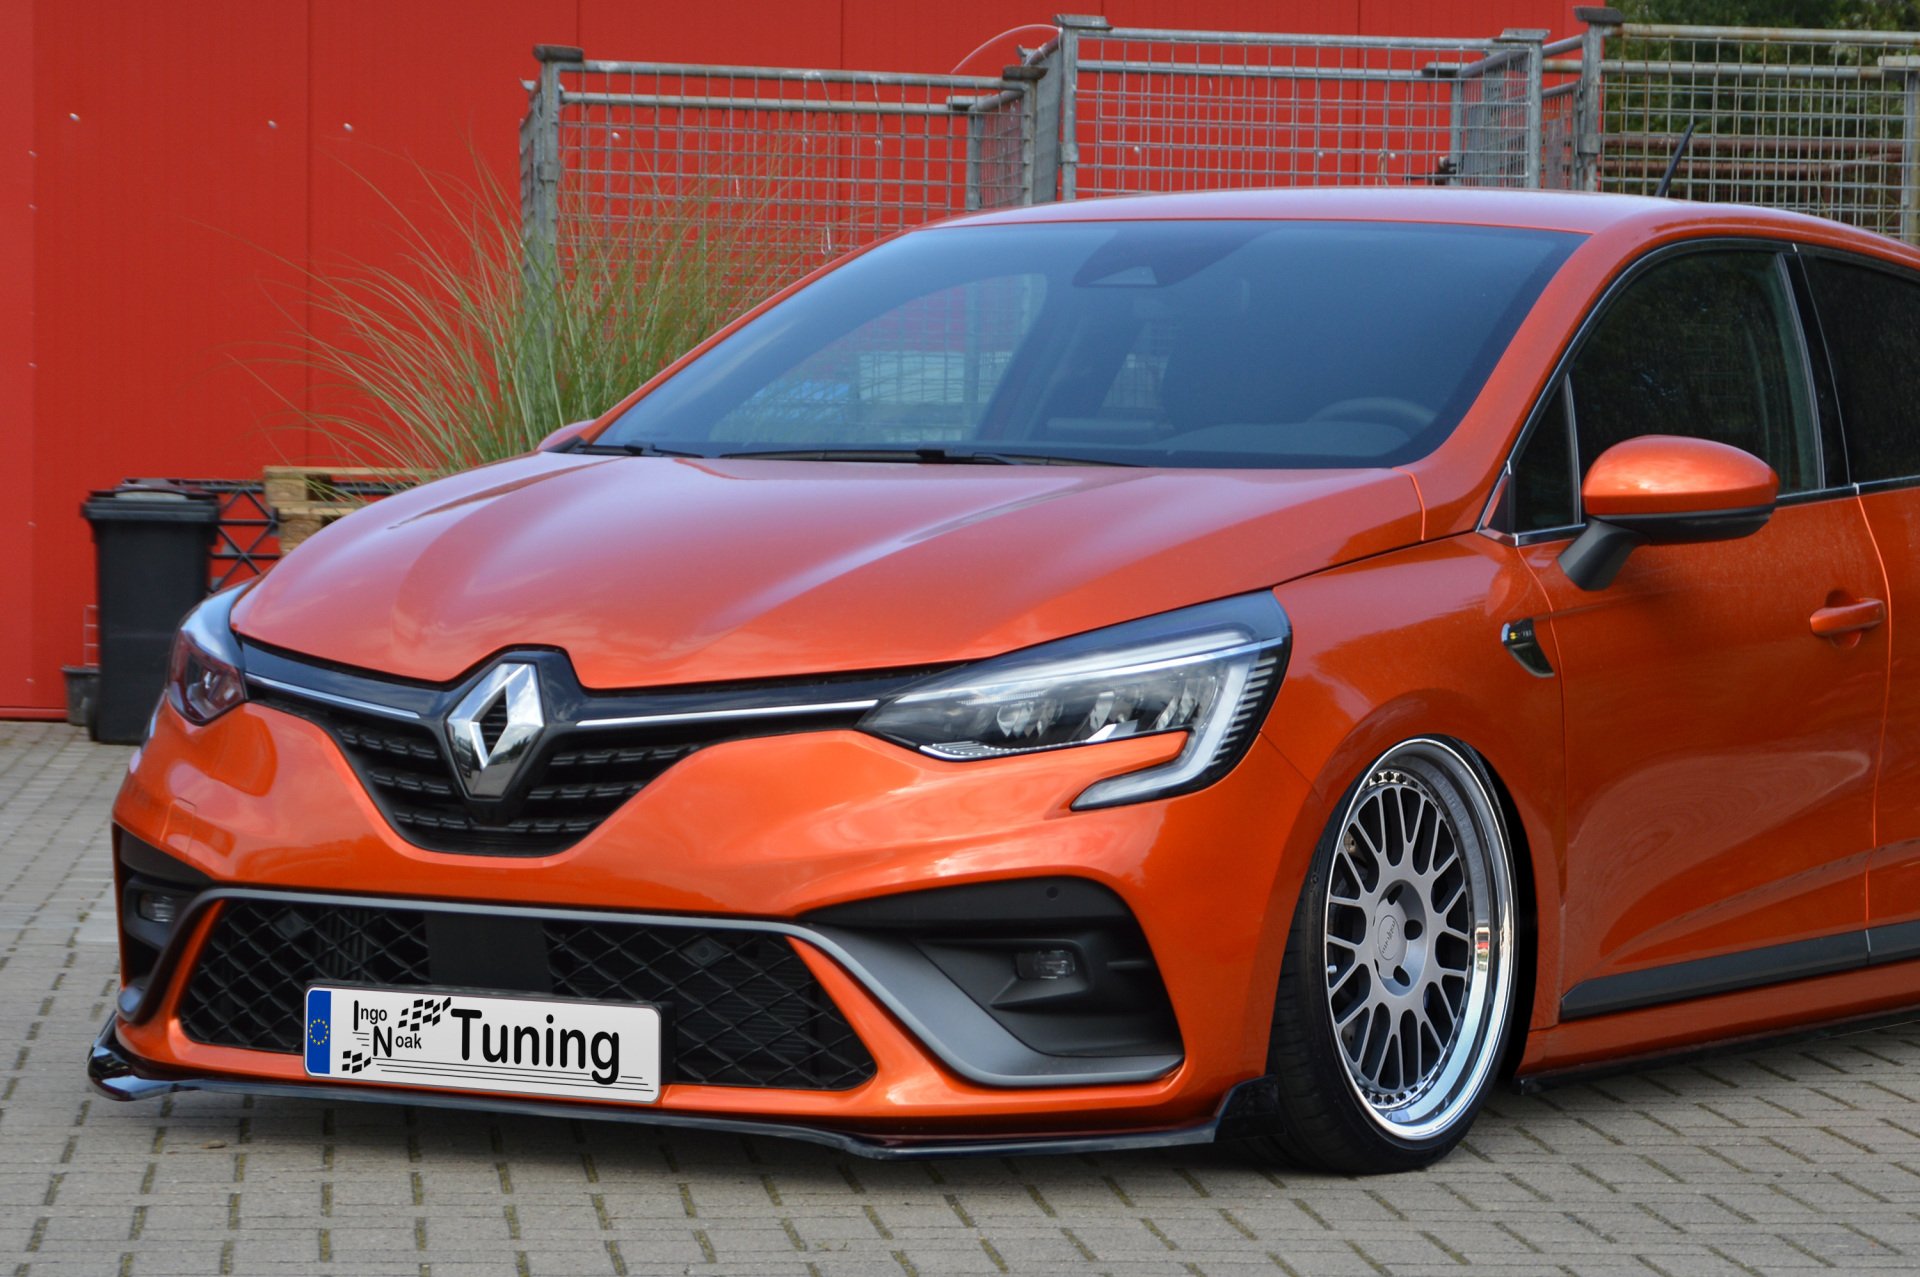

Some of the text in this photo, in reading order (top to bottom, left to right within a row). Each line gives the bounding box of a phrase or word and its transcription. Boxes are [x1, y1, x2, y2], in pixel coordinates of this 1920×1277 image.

[353, 1000, 387, 1031] Ingo
[373, 1025, 422, 1057] Noak
[450, 1008, 620, 1085] Tuning
